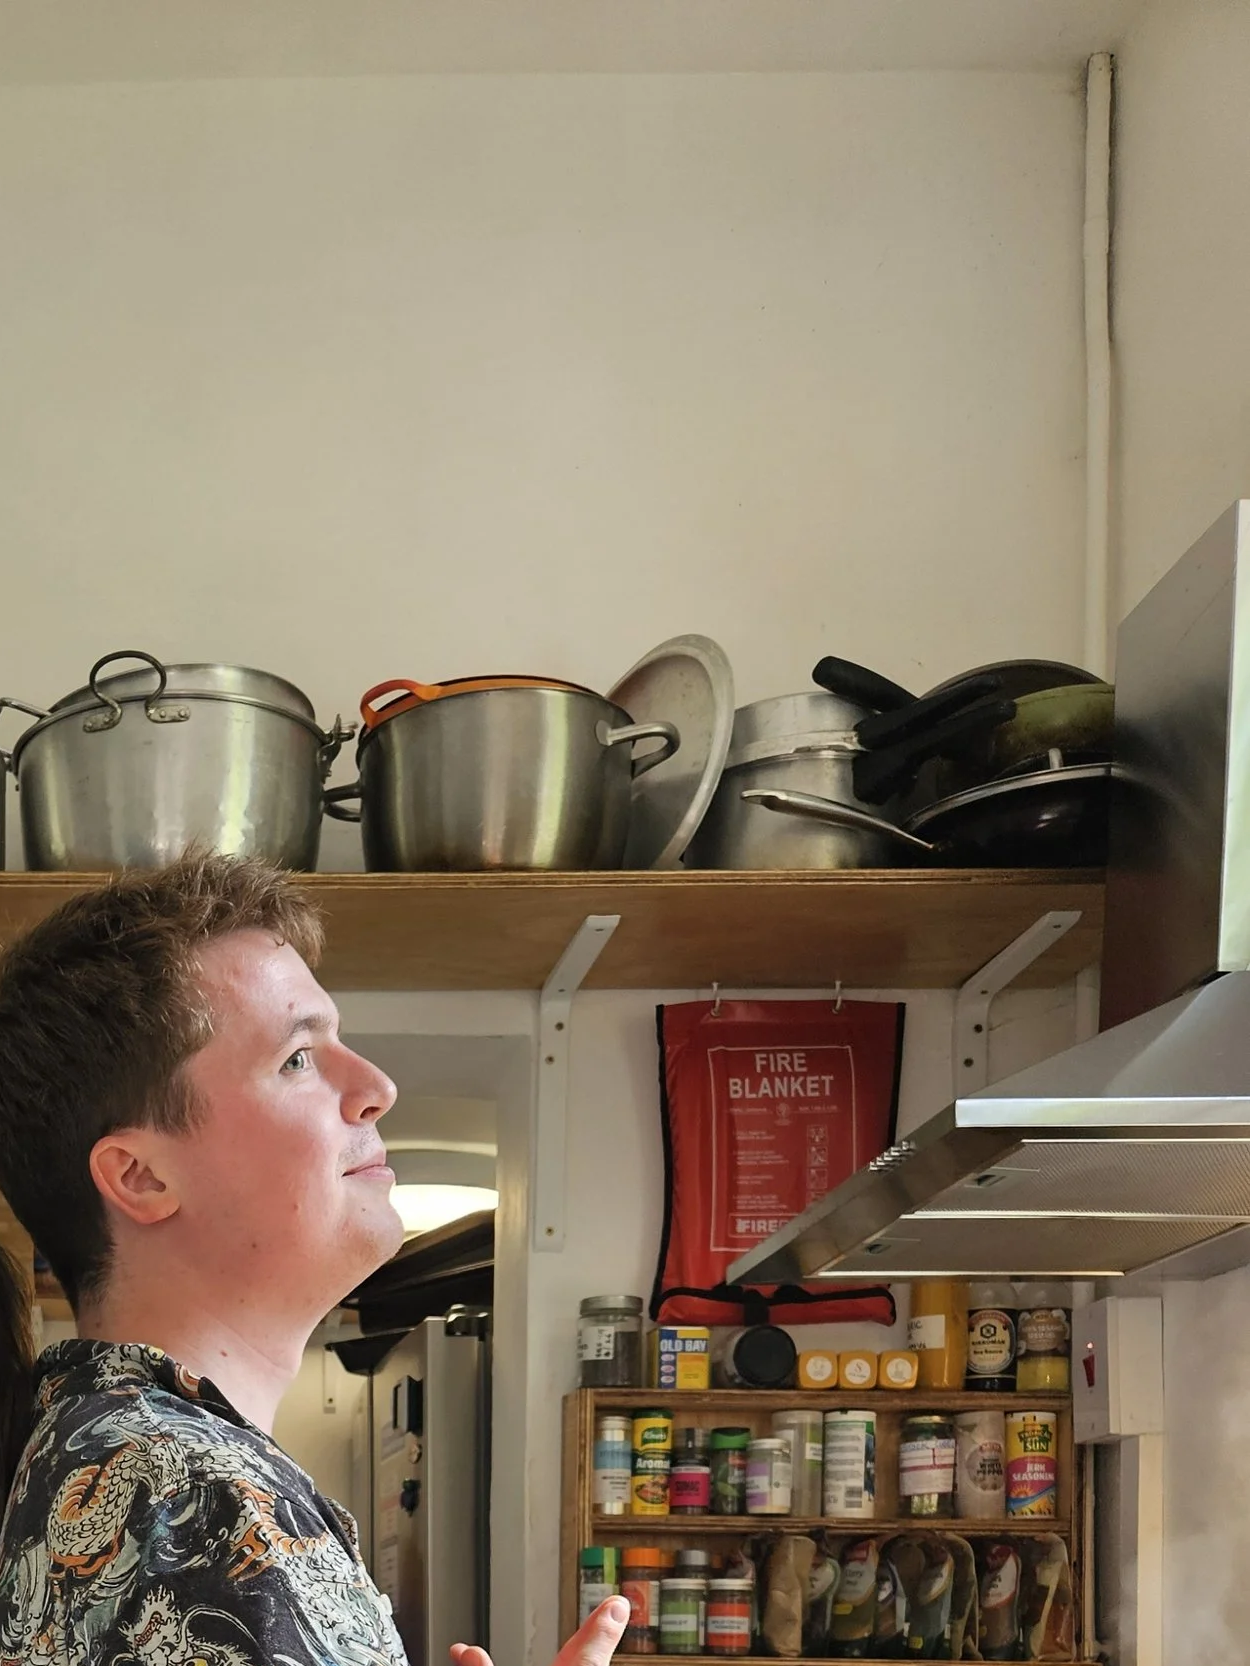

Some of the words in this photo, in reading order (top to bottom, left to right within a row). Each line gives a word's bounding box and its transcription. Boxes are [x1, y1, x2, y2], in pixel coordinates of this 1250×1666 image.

[755, 1052, 808, 1073] FIRE
[729, 1075, 834, 1099] BLANKET
[659, 1339, 683, 1352] OLD
[684, 1339, 707, 1352] BAY
[1026, 1440, 1048, 1451] SUN
